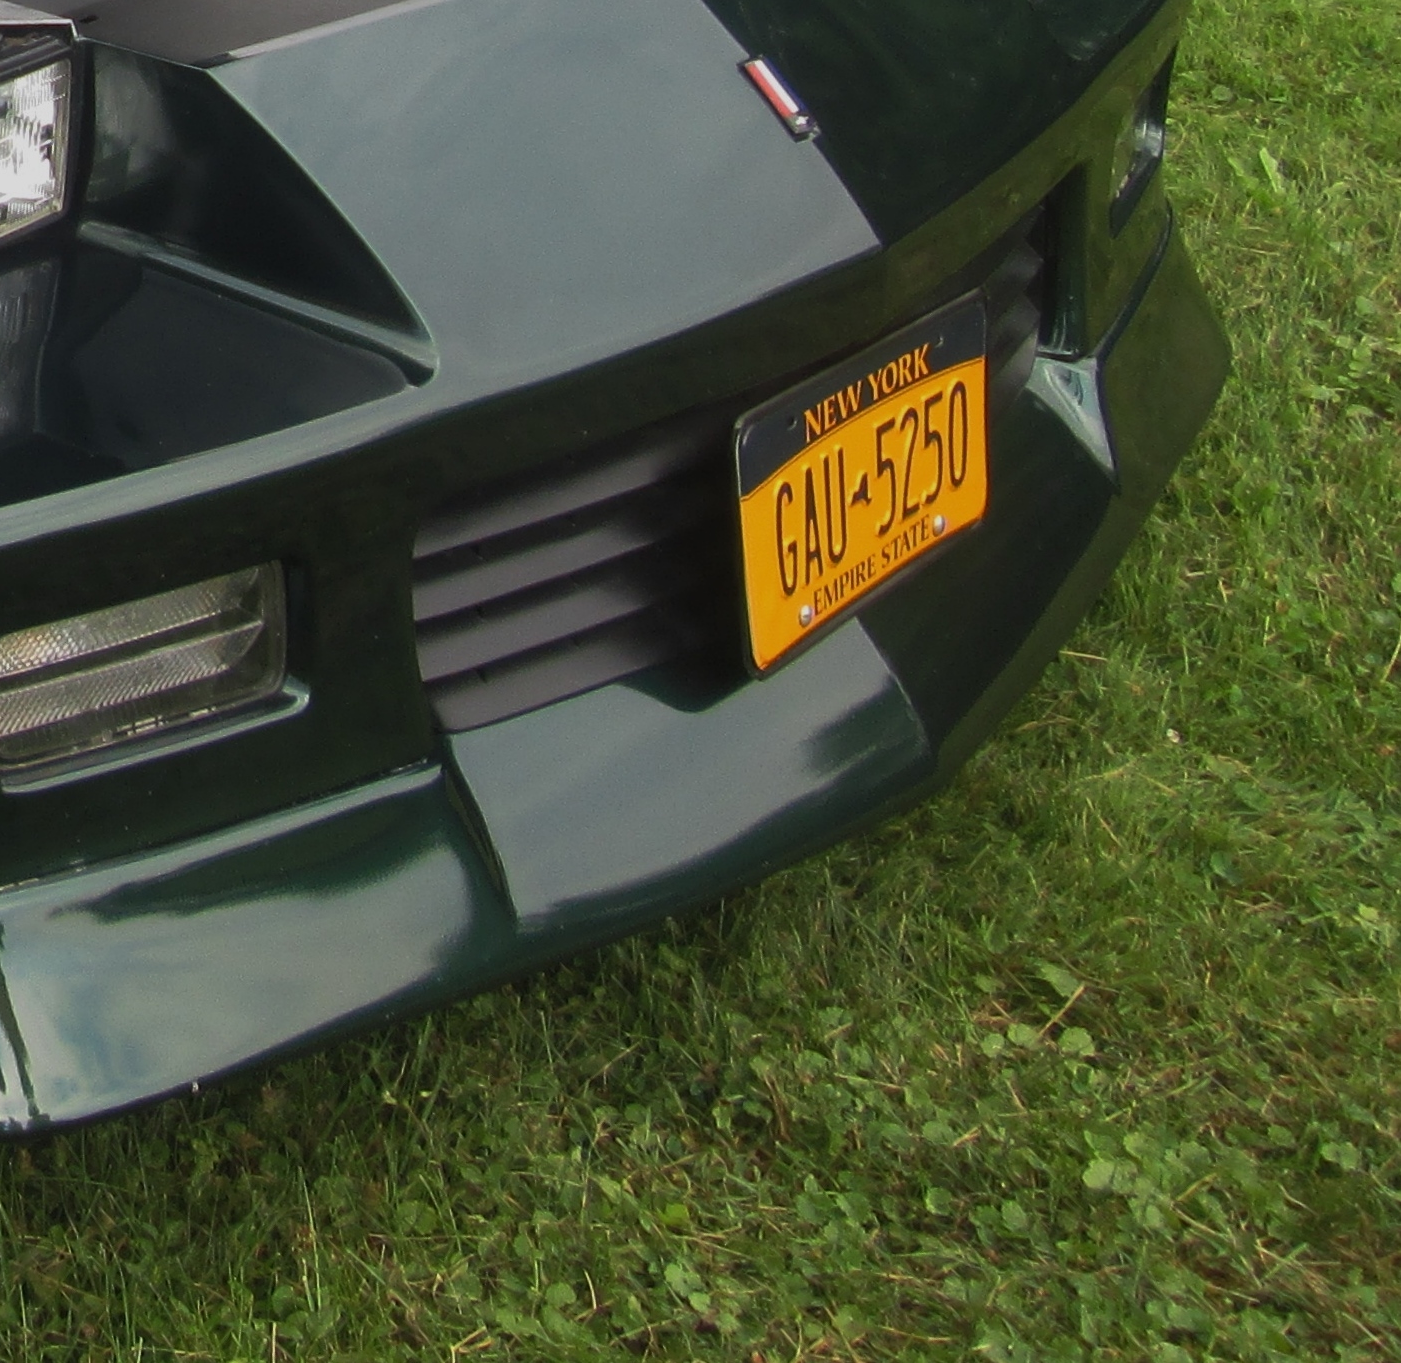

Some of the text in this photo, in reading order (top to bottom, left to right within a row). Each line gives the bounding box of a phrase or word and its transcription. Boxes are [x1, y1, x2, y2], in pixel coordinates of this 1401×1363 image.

[803, 342, 930, 444] NEW YORK
[774, 380, 969, 597] GAU 5250
[812, 514, 931, 617] EMPIRE STATE
